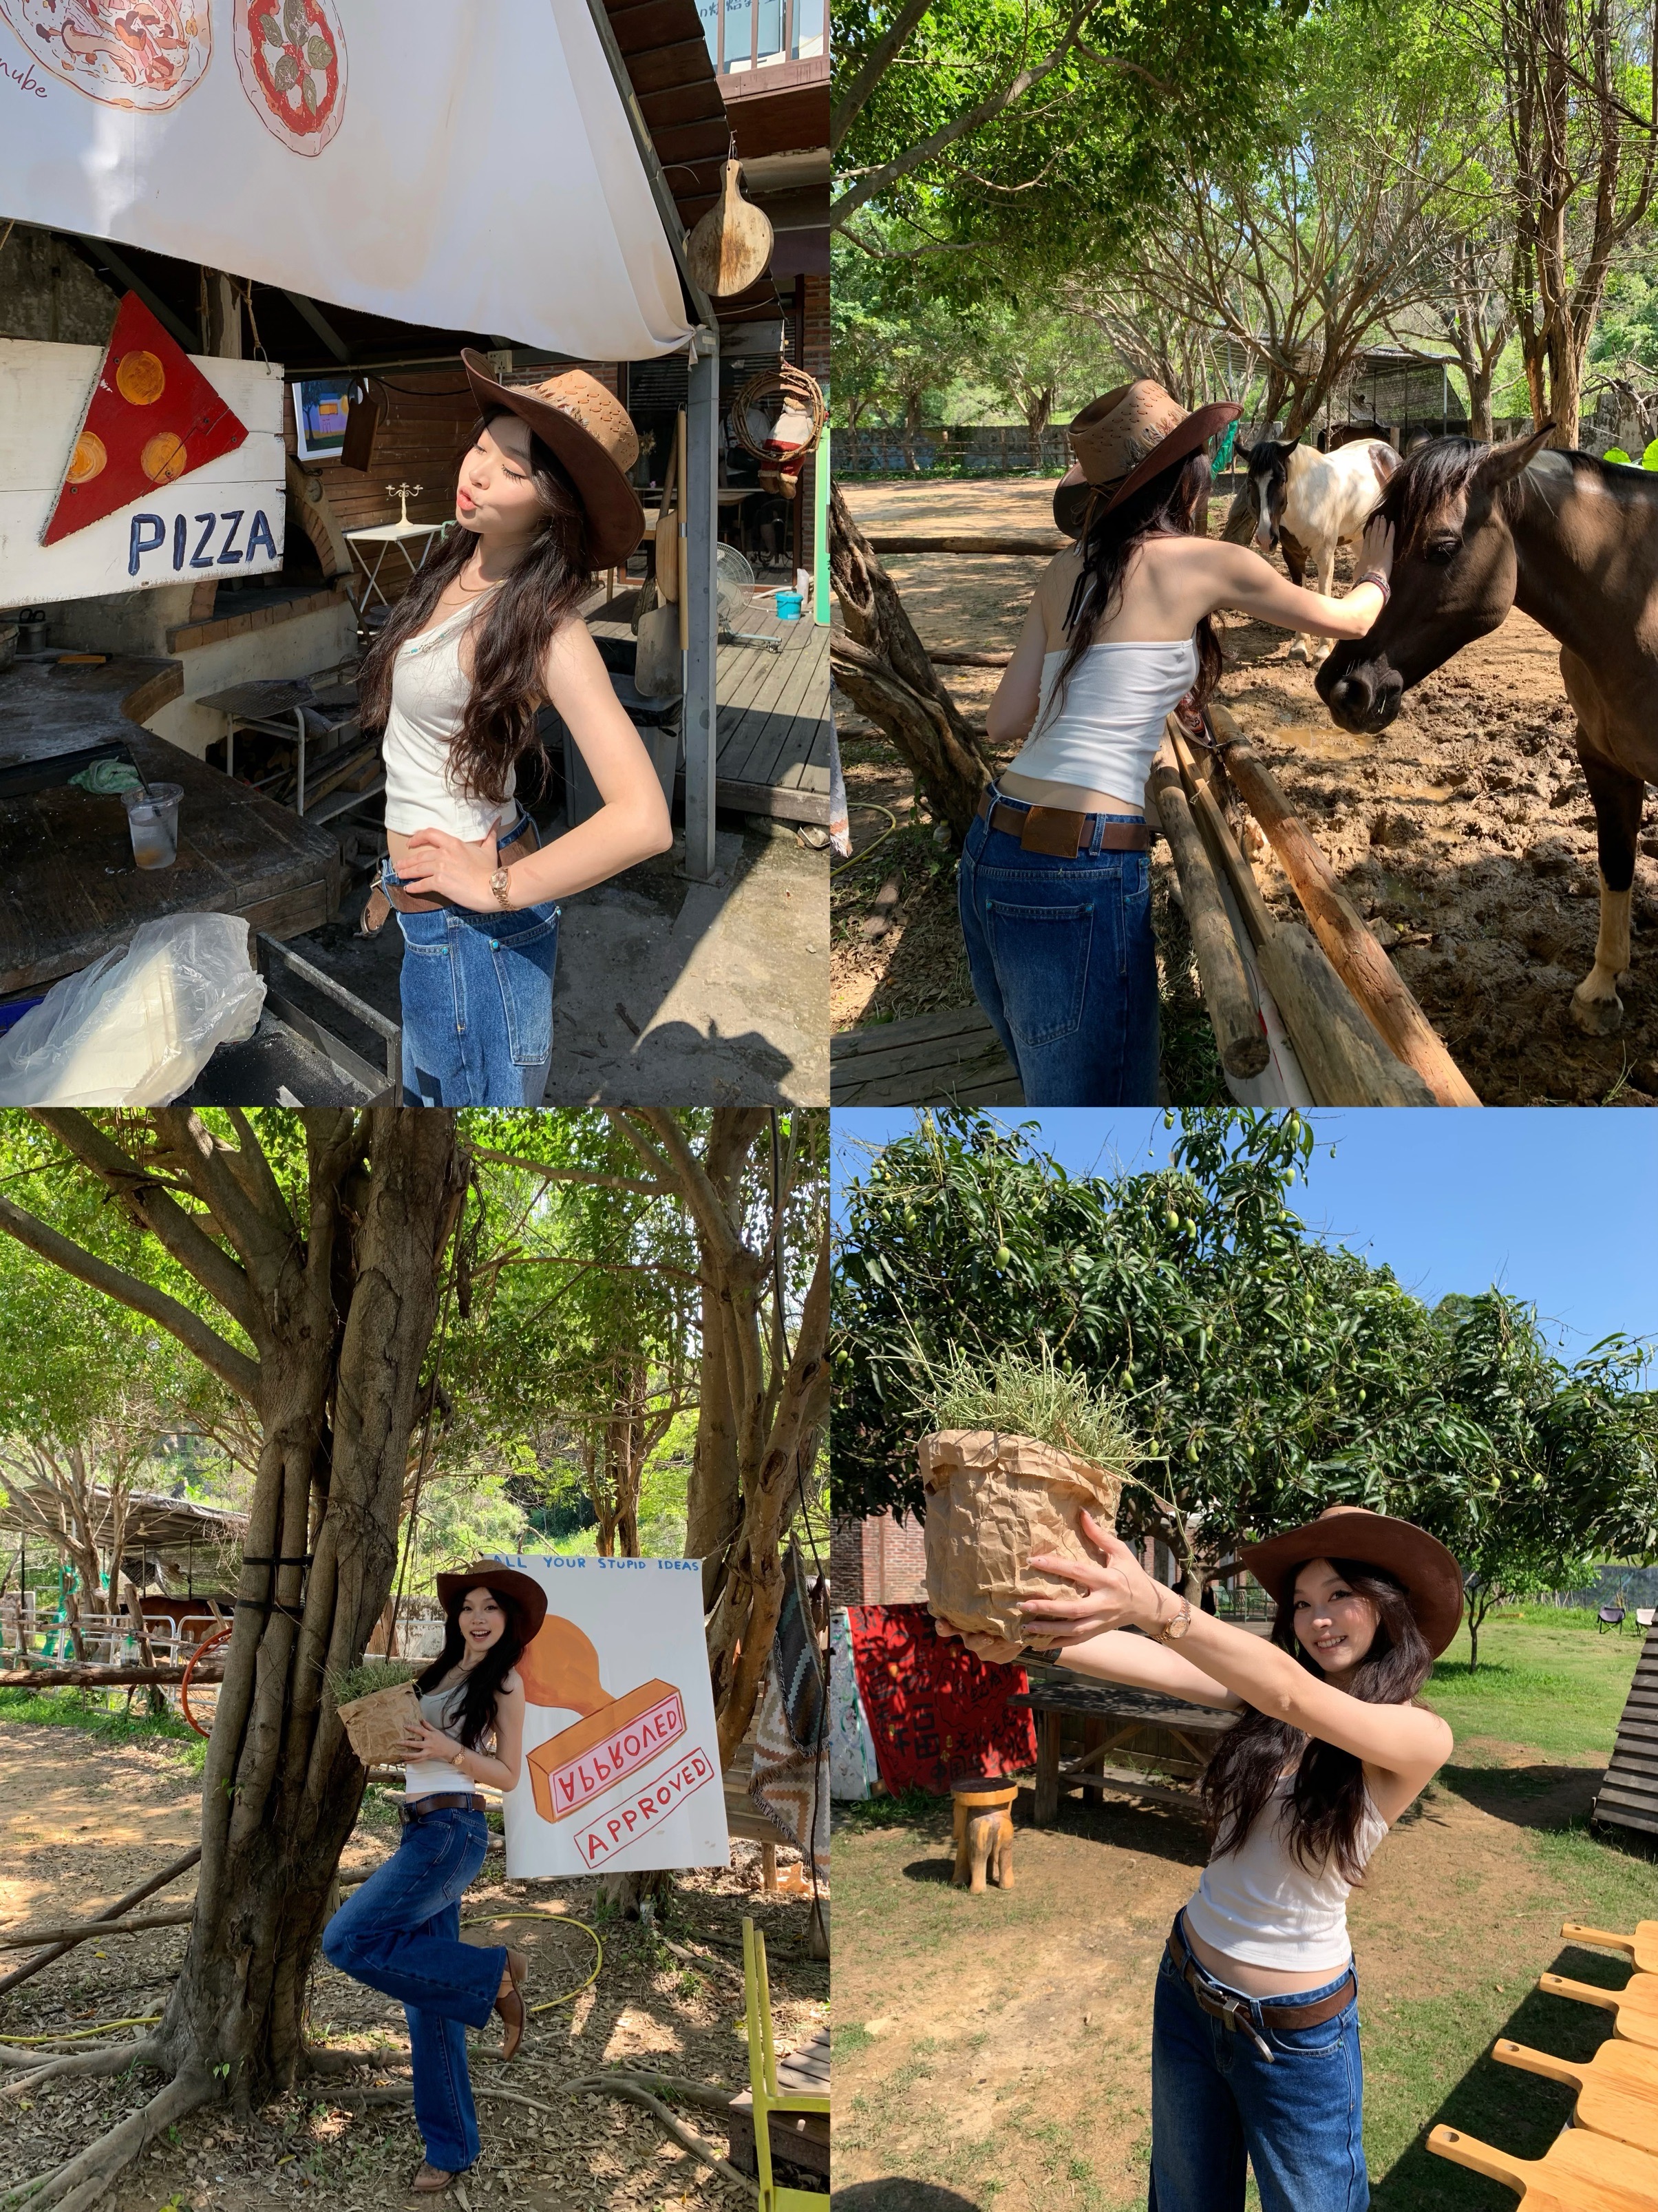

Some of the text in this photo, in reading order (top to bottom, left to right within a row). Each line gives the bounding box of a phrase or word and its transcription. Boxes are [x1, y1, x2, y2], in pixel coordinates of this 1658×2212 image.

[128, 509, 277, 576] PIZZA
[543, 1557, 586, 1568] YOUR
[597, 1557, 646, 1570] STUPID
[657, 1559, 699, 1571] IDEAS
[588, 1758, 706, 1860] APPROVED
